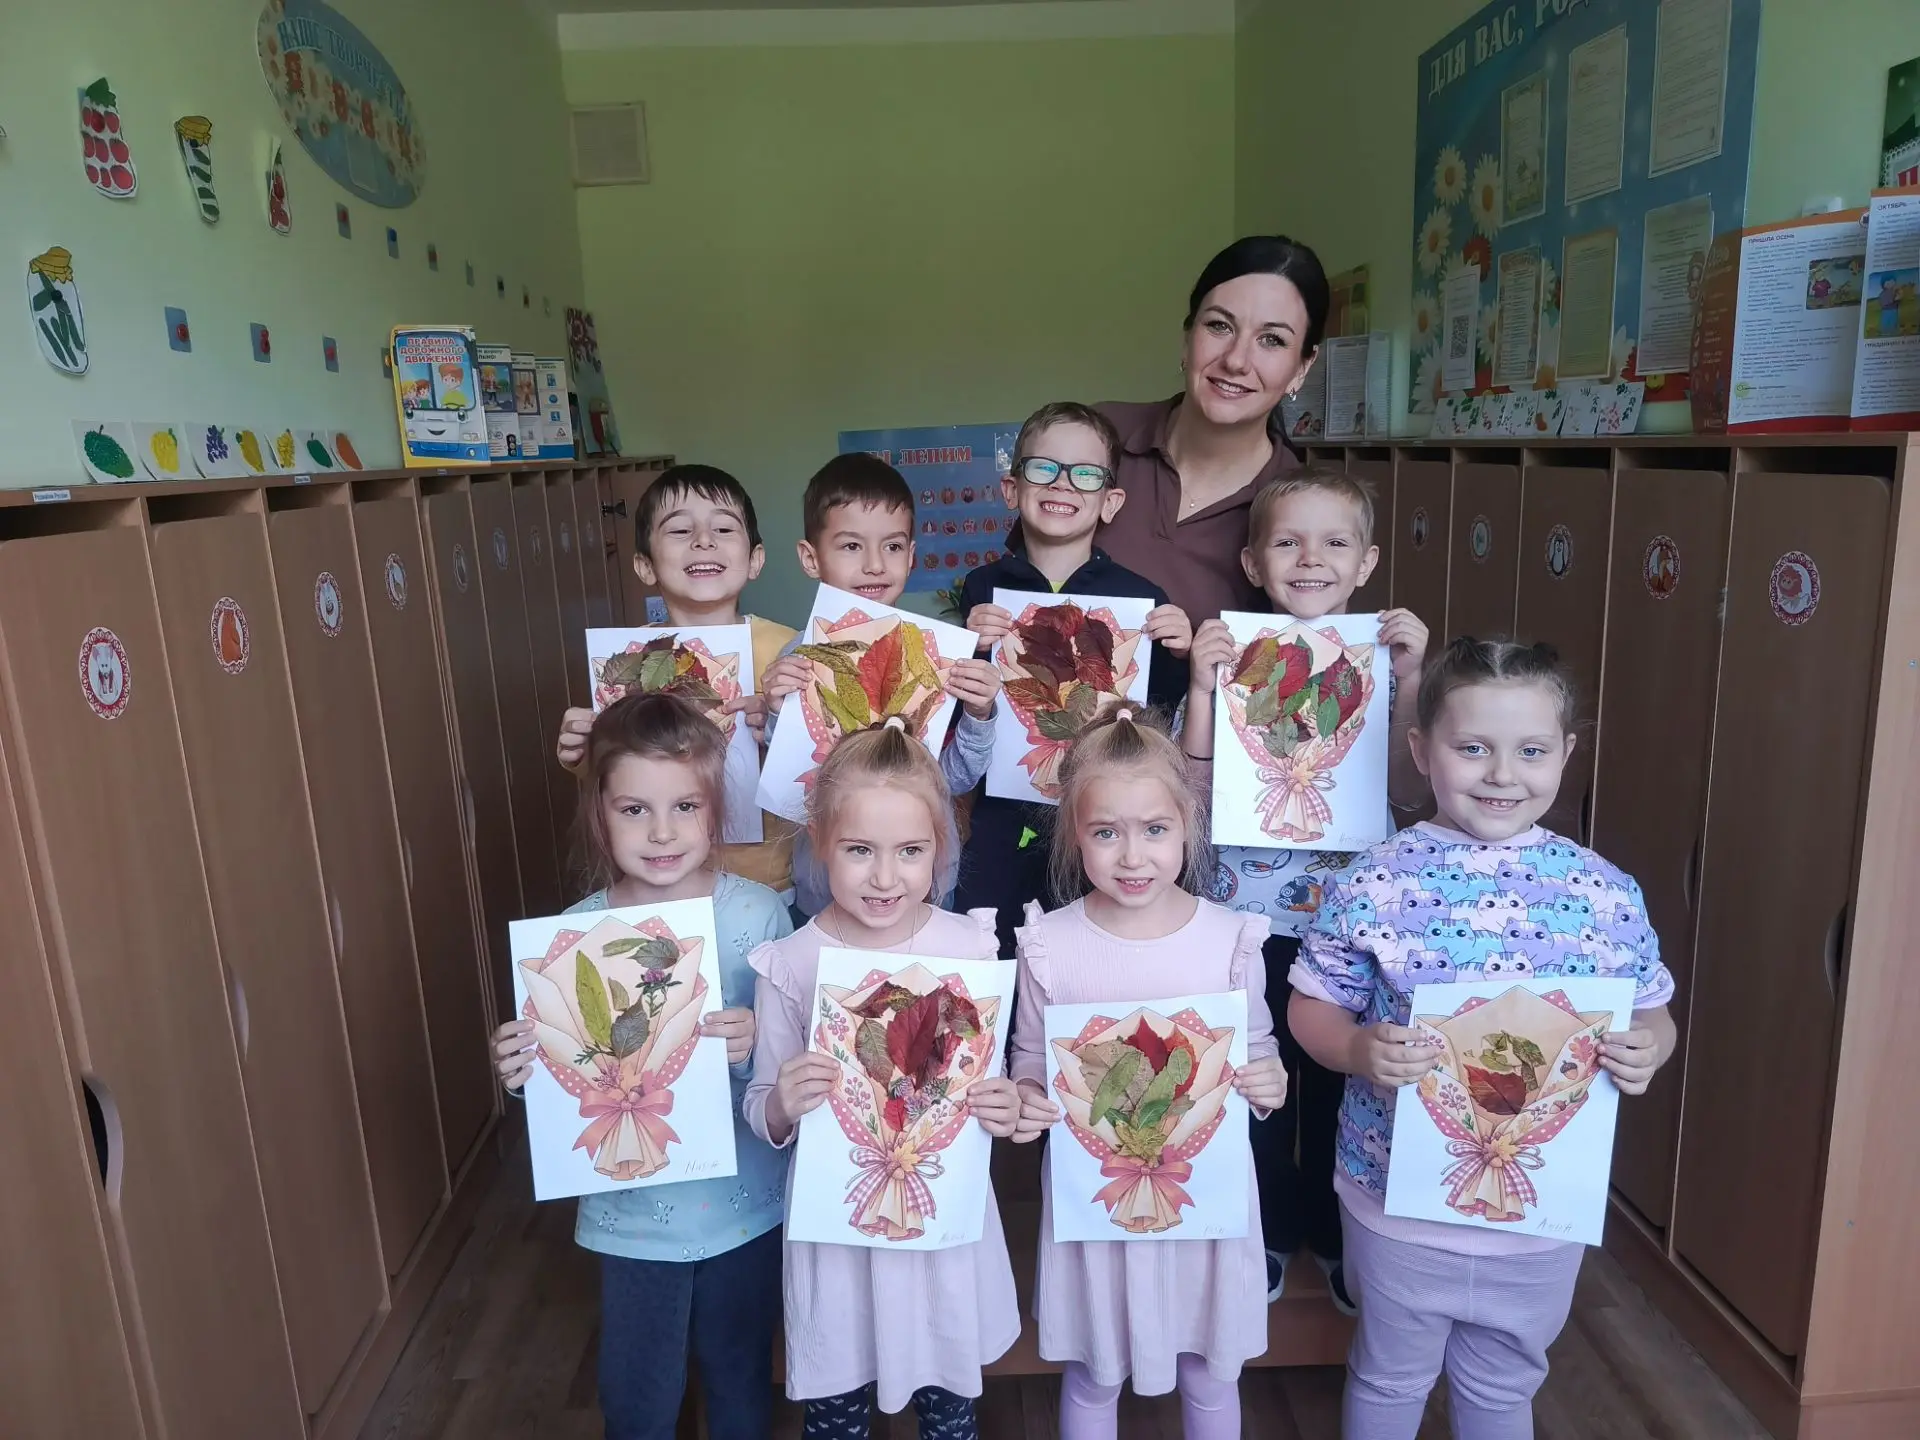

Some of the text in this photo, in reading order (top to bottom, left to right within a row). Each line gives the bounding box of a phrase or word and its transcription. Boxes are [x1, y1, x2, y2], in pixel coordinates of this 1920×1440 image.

[275, 17, 323, 53] НАШЕ
[1428, 38, 1467, 105] ДЛЯ
[1474, 5, 1525, 67] ВАС,
[407, 338, 456, 346] ПРАВИЛА
[400, 347, 465, 355] ДОРОЖНОГО
[405, 355, 462, 364] ДВИЖЕНИЯ
[899, 446, 972, 466] ЛЕПИМ
